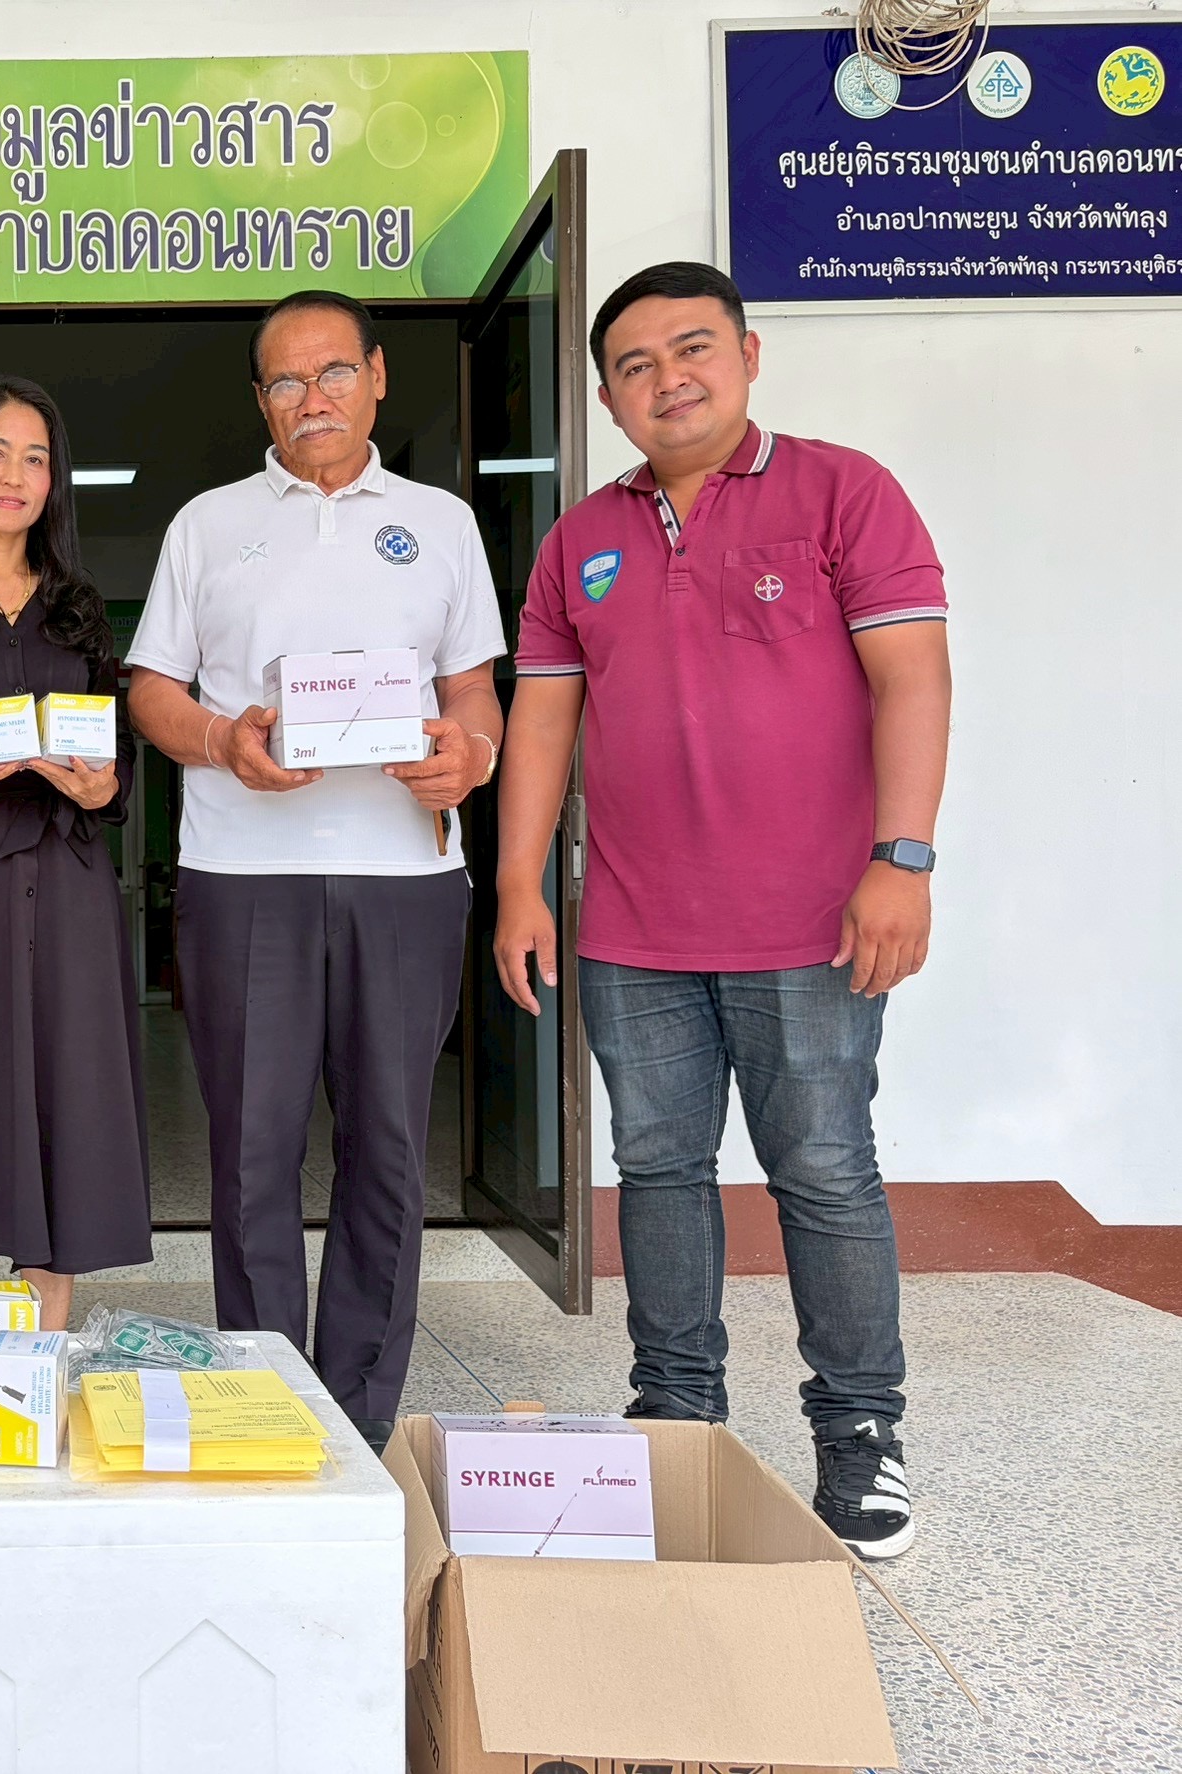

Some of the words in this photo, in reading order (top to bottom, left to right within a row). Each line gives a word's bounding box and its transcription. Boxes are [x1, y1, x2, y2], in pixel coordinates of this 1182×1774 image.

[836, 205, 1018, 240] อำเภอปากพะยูน
[1027, 202, 1167, 238] จังหวัดพัทลุง
[799, 255, 1058, 283] สำนักงานยุติธรรมจังหวัดพัทลุง
[290, 678, 356, 693] SYRINGE
[293, 747, 316, 759] 3ml
[16, 1307, 26, 1331] JNM
[461, 1470, 556, 1487] SYRINGE
